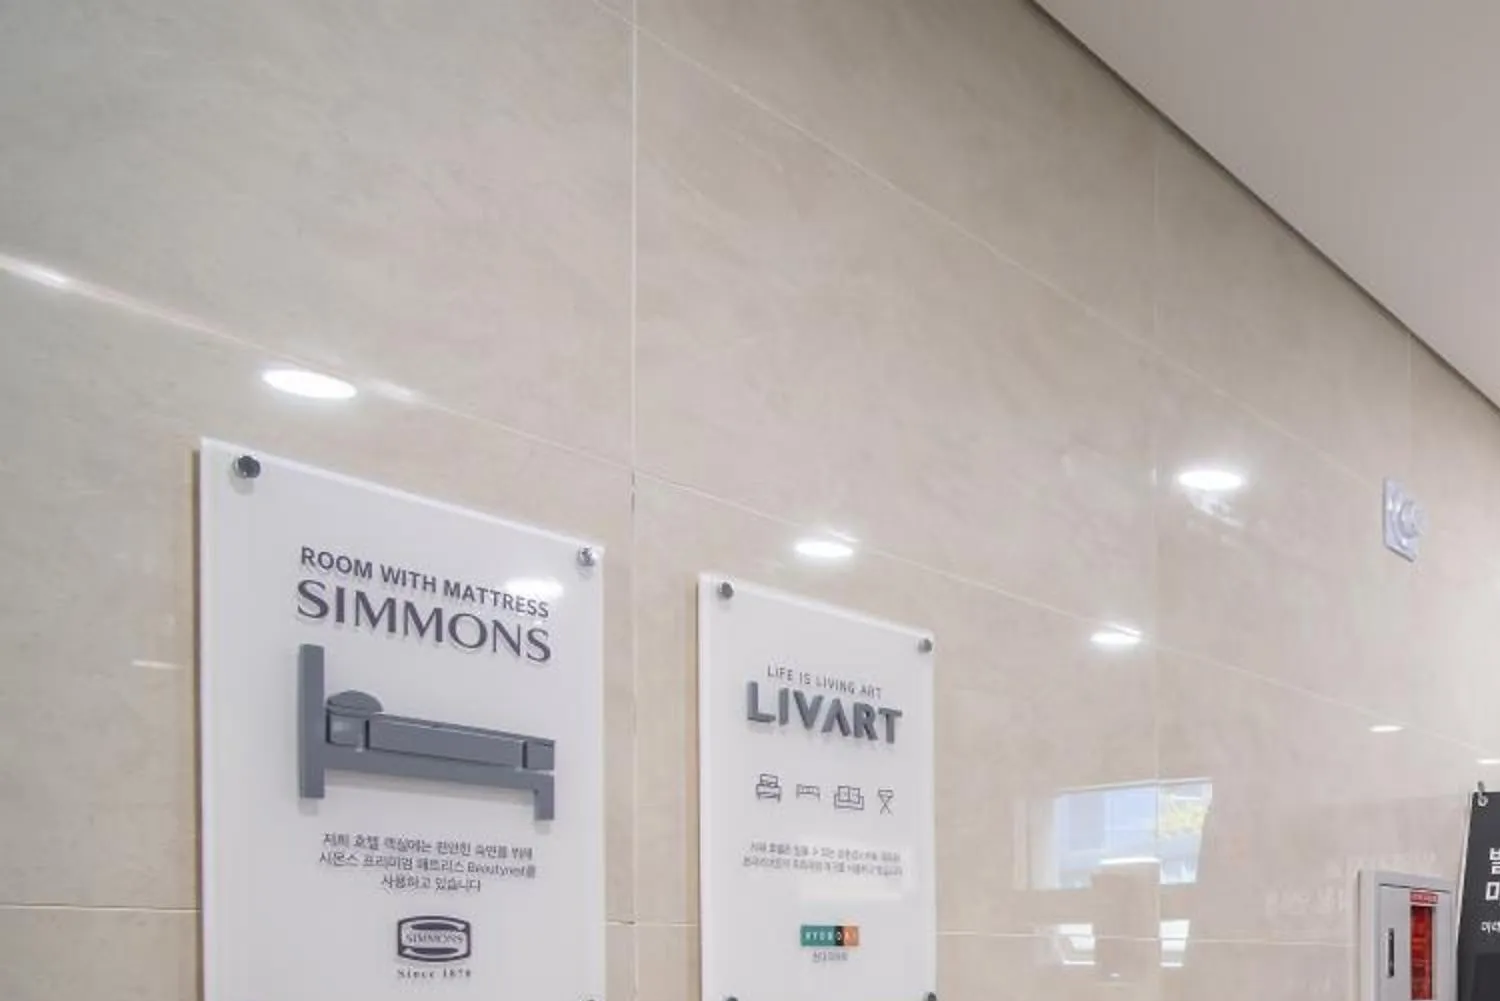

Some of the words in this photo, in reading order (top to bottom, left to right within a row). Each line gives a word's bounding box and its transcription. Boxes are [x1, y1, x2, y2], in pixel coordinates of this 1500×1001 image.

[301, 546, 373, 580] ROOM
[381, 564, 437, 593] WITH
[443, 579, 549, 618] MATTRESS
[297, 580, 552, 663] SIMMONS
[767, 665, 793, 681] LIFE
[800, 671, 811, 685] IS
[816, 675, 855, 694] LIVING
[860, 684, 882, 699] ART
[747, 680, 903, 744] LIVART
[319, 850, 359, 867] 시몬스
[363, 854, 413, 871] 프리미엄
[381, 874, 431, 891] 사용하고
[406, 932, 464, 944] SIMMONS
